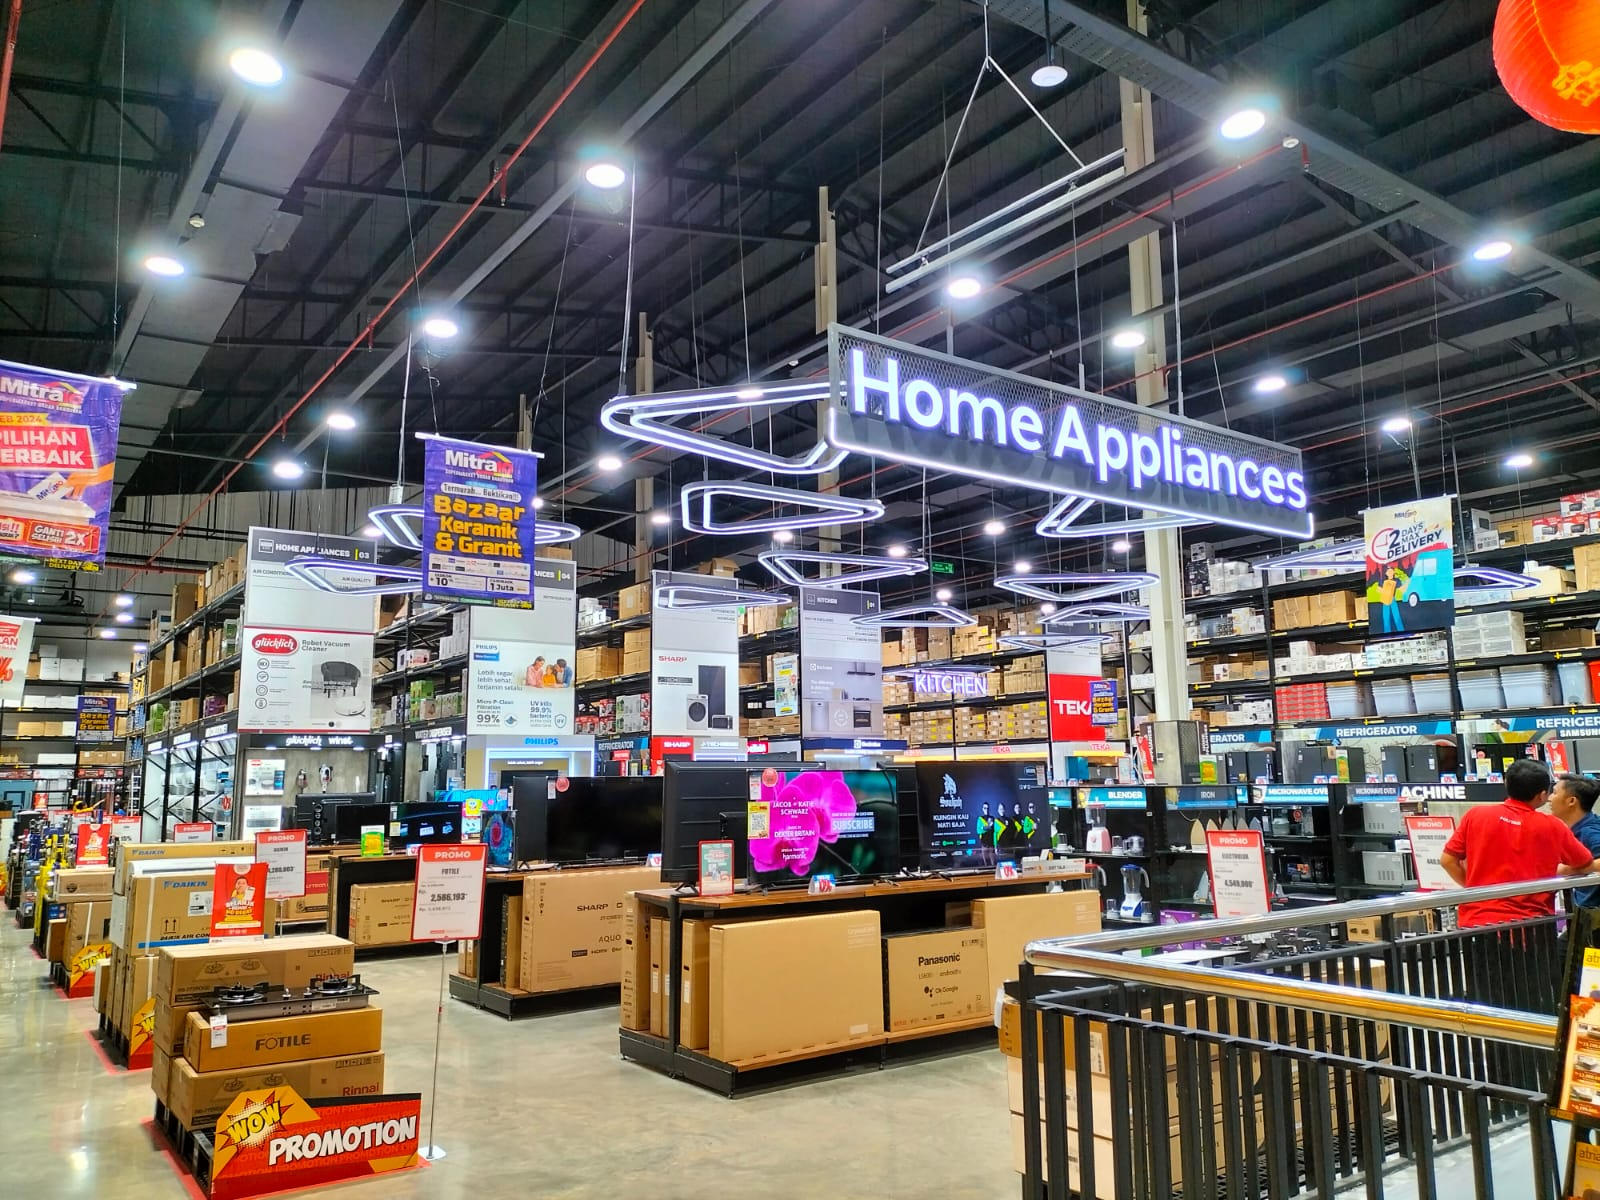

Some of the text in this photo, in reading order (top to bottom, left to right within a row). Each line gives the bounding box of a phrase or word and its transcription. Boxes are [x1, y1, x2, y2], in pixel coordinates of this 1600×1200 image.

[850, 347, 1309, 510] Home Appliances
[0, 429, 77, 446] ILIHAN
[433, 494, 526, 522] Bazaar
[440, 515, 519, 541] Keramik
[64, 530, 86, 547] 2X
[1389, 522, 1424, 550] 2 DAYS
[1401, 531, 1420, 544] MAX
[275, 543, 300, 551] HOME
[359, 551, 370, 559] 03
[435, 532, 523, 558] & Granit
[1387, 529, 1442, 560] DELIVERY
[496, 584, 515, 592] Juta
[914, 674, 988, 695] KITCHEN
[477, 714, 500, 723] 99%
[1336, 725, 1418, 738] REFRIGERATOR
[1560, 729, 1600, 738] SAMSUN
[524, 737, 559, 746] PHILIPS
[1210, 734, 1245, 743] ERATOR
[598, 741, 634, 750] REFRIGERATOR
[1108, 791, 1143, 799] BLENDER
[1201, 791, 1216, 799] IRON
[1268, 788, 1328, 796] MICROWAVE OVE
[1401, 785, 1466, 800] ACHINE
[833, 819, 873, 830] SUBSCRIBE
[1219, 837, 1248, 845] PROMO
[434, 851, 472, 859] PROMO
[819, 879, 832, 892] 0%
[577, 903, 609, 911] SHARP
[598, 934, 622, 943] AQUO
[79, 953, 108, 971] WOW
[918, 952, 961, 967] Panasonic
[255, 1034, 312, 1050] FOTILE
[343, 1085, 380, 1097] Rinnai
[227, 1101, 281, 1144] WOW
[268, 1115, 417, 1166] PROMOTION
